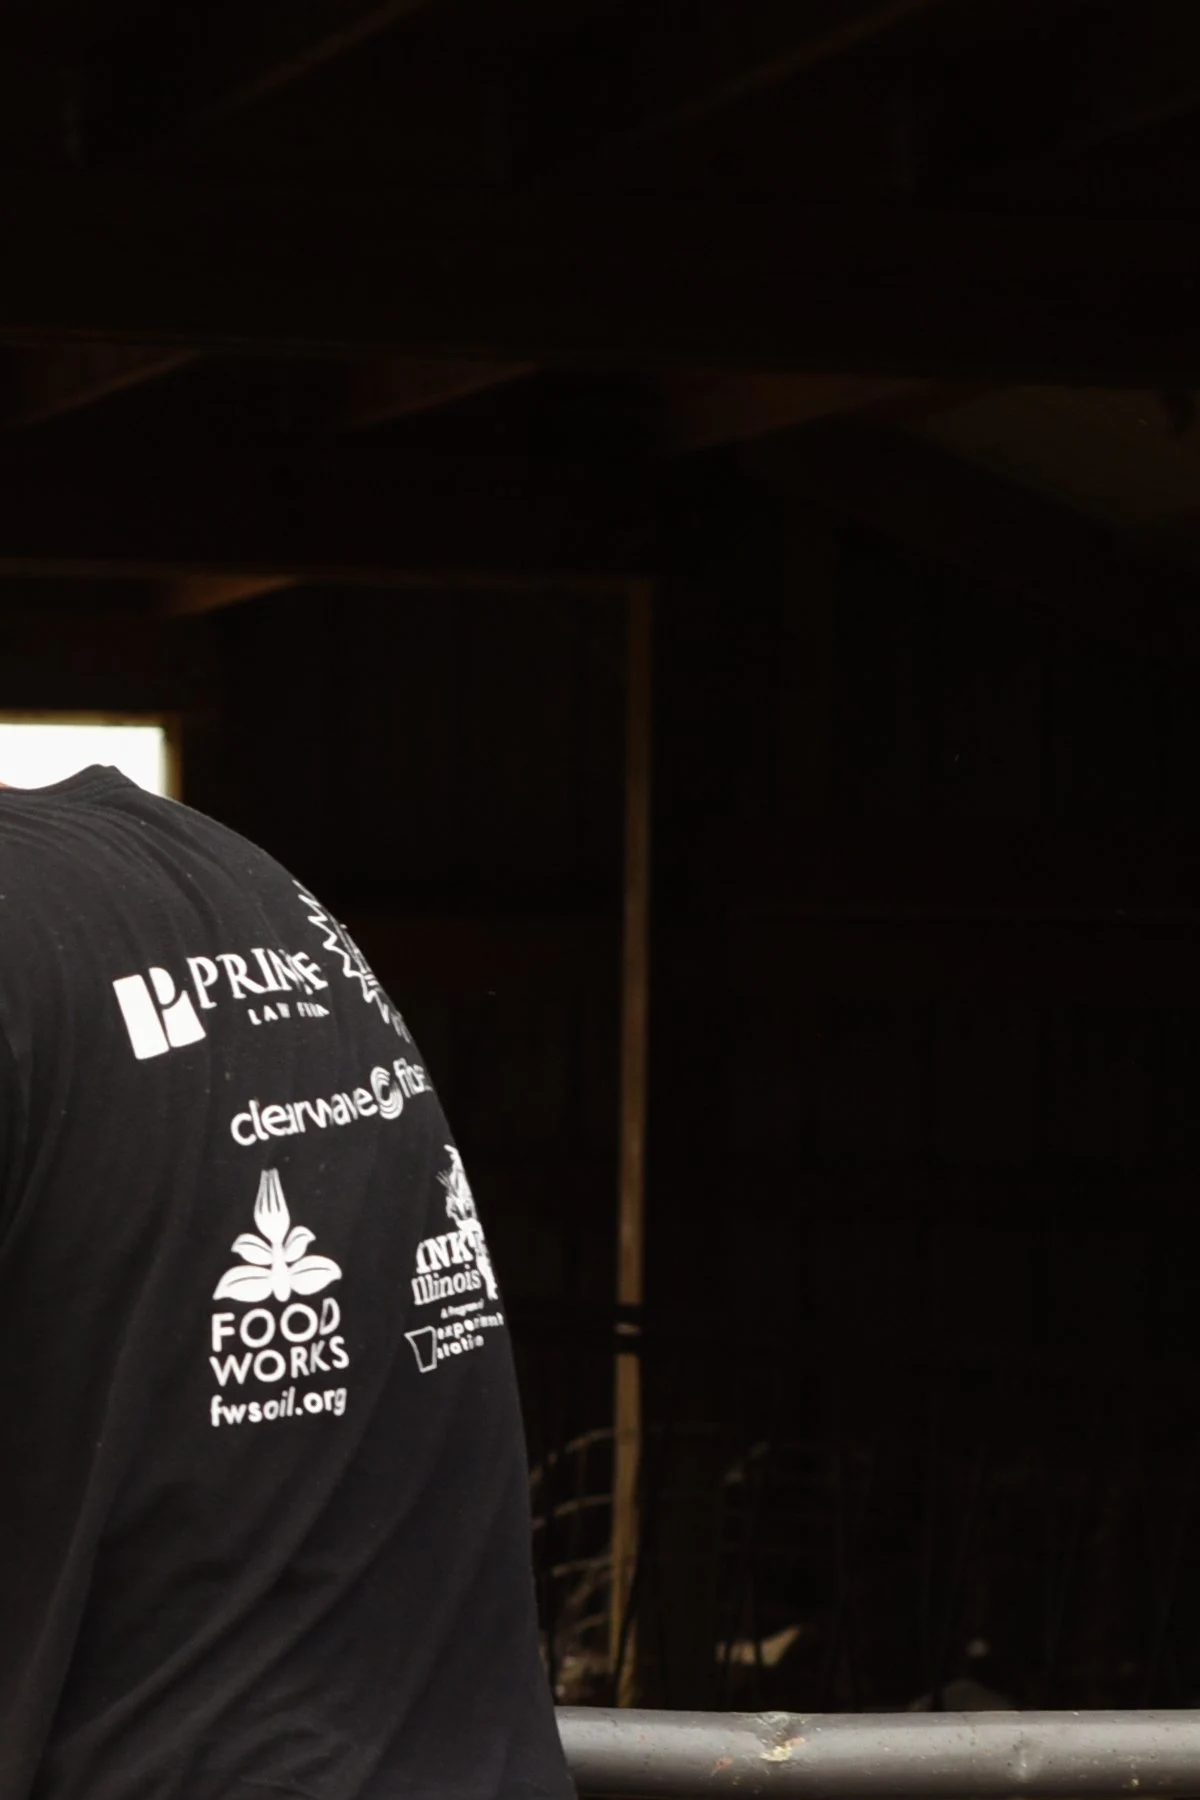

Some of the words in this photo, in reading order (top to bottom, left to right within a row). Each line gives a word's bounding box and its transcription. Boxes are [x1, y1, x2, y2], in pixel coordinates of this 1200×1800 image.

[410, 1264, 482, 1305] Illinois
[211, 1298, 341, 1352] FOOD
[209, 1336, 349, 1386] WORKS
[211, 1387, 347, 1427] fwsoil.org
